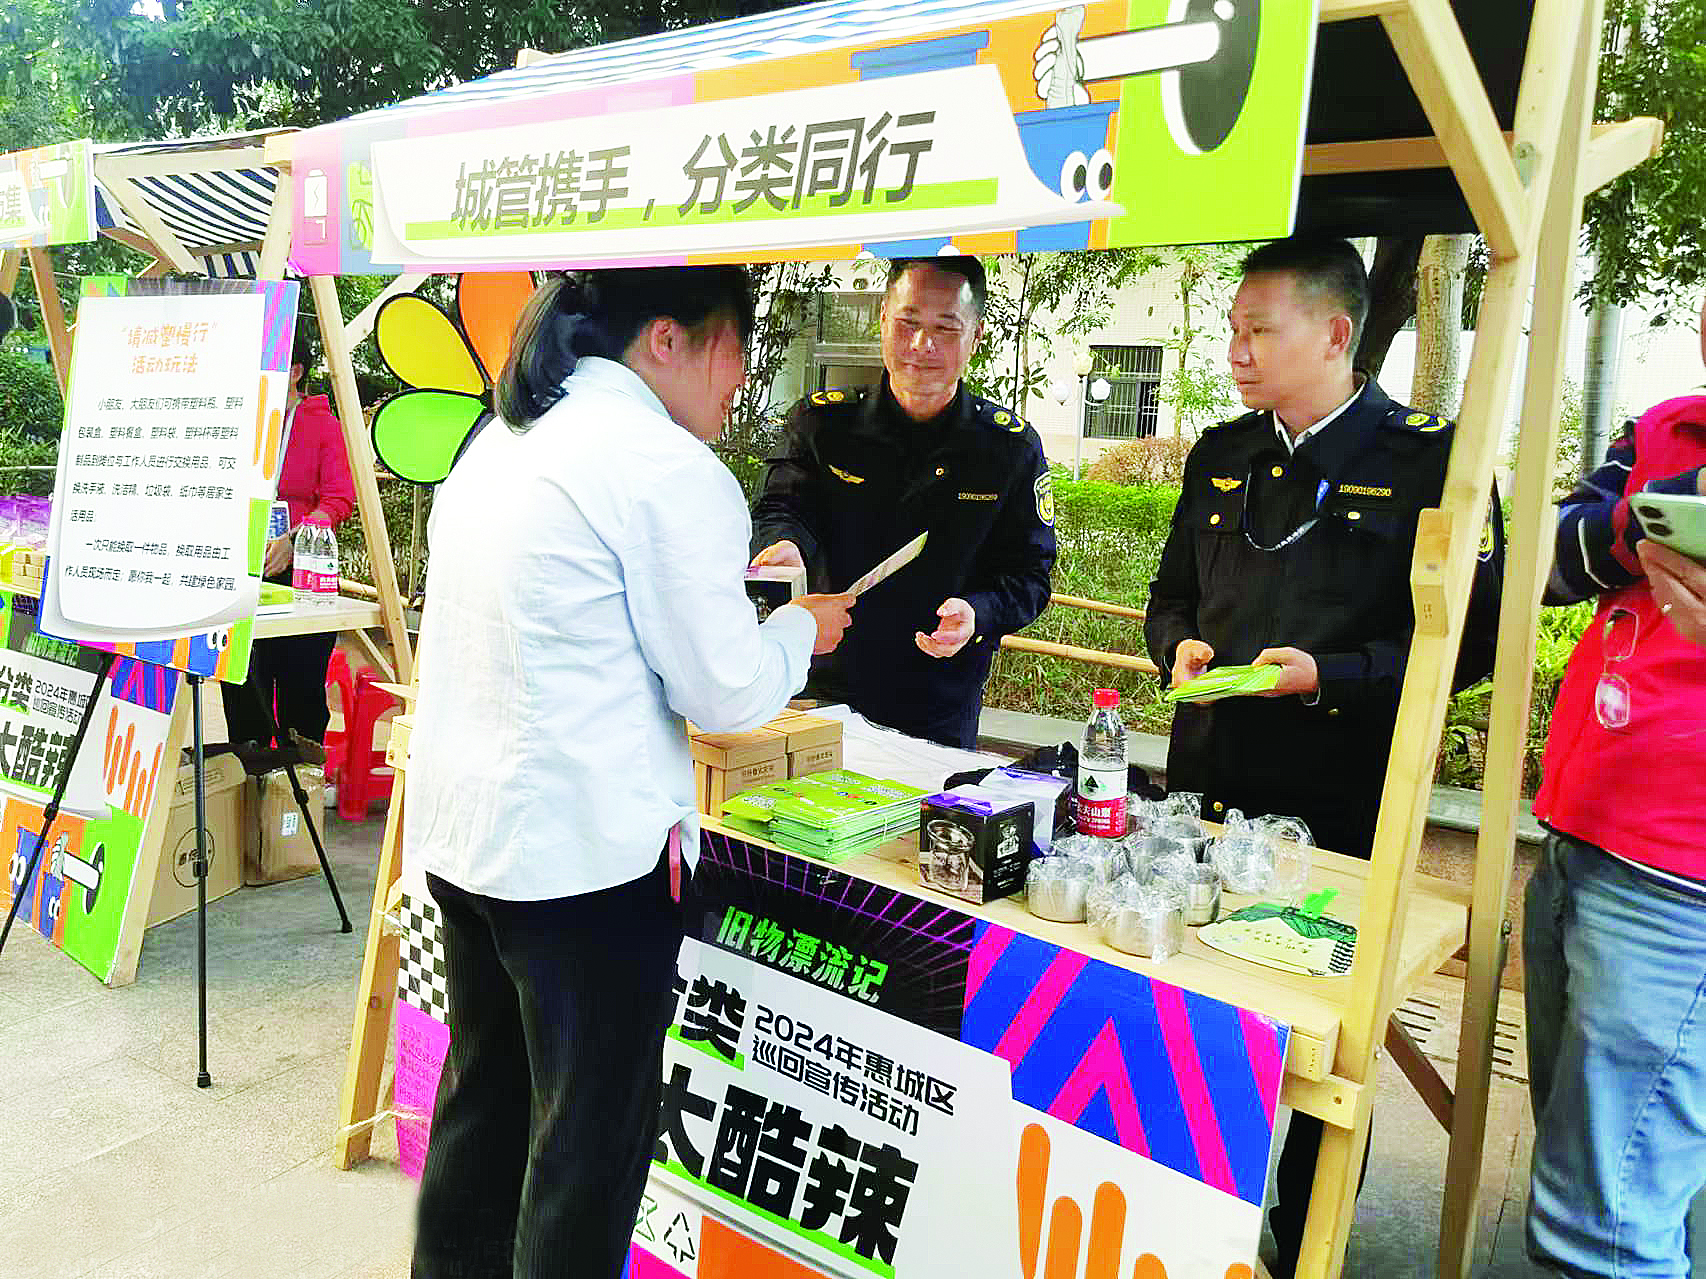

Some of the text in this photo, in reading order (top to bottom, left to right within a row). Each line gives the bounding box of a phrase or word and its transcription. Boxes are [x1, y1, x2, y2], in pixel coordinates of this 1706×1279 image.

[0, 184, 22, 224] 集
[451, 111, 936, 231] 城管携手，分类同行
[132, 352, 198, 375] 活动玩法
[717, 906, 889, 1003] 旧物漂流记
[671, 974, 747, 1061] 类
[755, 1004, 957, 1116] 2024年惠城区
[752, 1034, 919, 1136] 巡回宣传活动
